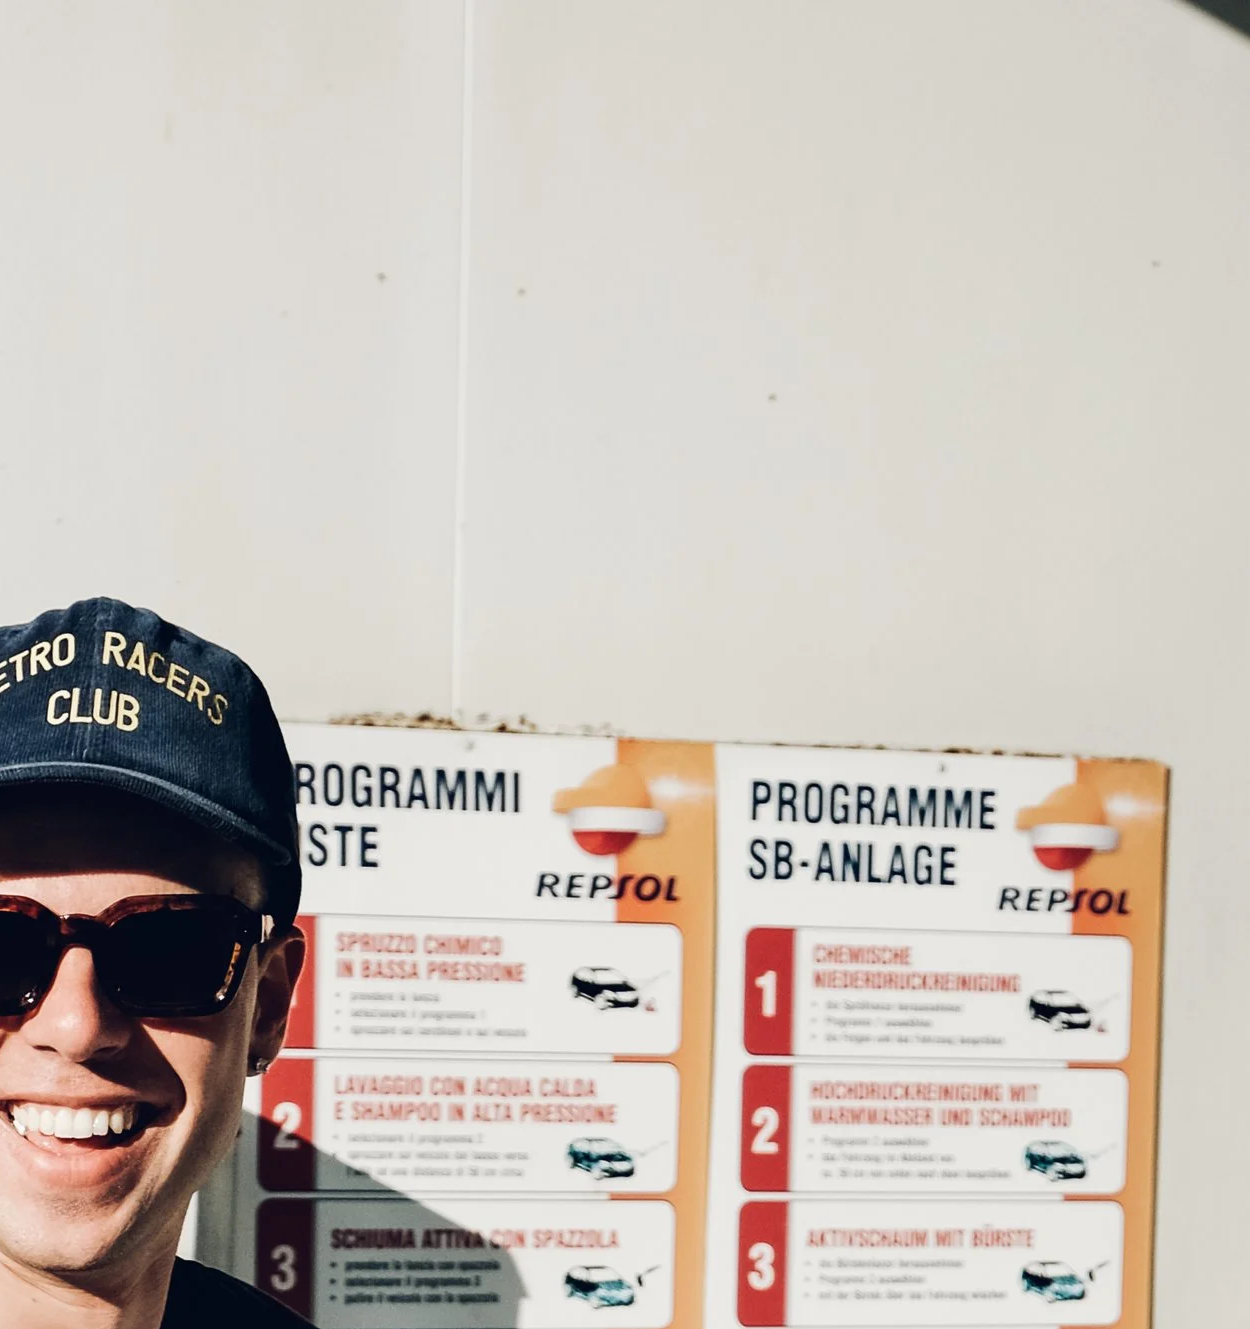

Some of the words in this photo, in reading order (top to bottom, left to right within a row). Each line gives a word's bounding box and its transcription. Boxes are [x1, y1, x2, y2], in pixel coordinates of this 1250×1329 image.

[102, 630, 229, 726] RACERS
[46, 687, 141, 731] CLUB
[295, 763, 520, 813] ROGRAMMI
[750, 781, 997, 830] PROGRAMME
[300, 823, 379, 868] STE
[748, 838, 957, 886] SB-ANLAGE
[536, 873, 681, 901] REPSOL
[998, 887, 1132, 915] REPSOL
[336, 932, 417, 953] SPRUZZO
[424, 935, 503, 956] CHIMICO
[813, 944, 912, 965] CHEMISCHE
[336, 958, 354, 978] IN
[361, 959, 419, 980] BASSA
[427, 961, 525, 982] PRESSIONE
[754, 971, 777, 1018] 1
[334, 1075, 423, 1096] LAVAGGIO
[430, 1076, 466, 1096] CON
[473, 1077, 533, 1098] ACQUA
[539, 1078, 597, 1098] CALDA
[1009, 1083, 1039, 1102] MIT
[272, 1101, 303, 1149] 2
[334, 1101, 344, 1120] E
[352, 1101, 442, 1121] SHAMPOO
[448, 1102, 466, 1121] IN
[472, 1103, 514, 1122] ALTA
[520, 1103, 617, 1123] PRESSIONE
[751, 1106, 779, 1154] 2
[940, 1107, 973, 1126] UND
[331, 1228, 415, 1249] SCHIUMA
[421, 1228, 485, 1249] ATTIVA
[490, 1228, 526, 1249] CON
[533, 1229, 620, 1248] SPAZZOLA
[806, 1229, 928, 1249] AKTIVSCHAUM
[935, 1229, 964, 1248] MIT
[271, 1244, 296, 1291] 3
[748, 1243, 775, 1290] 3
